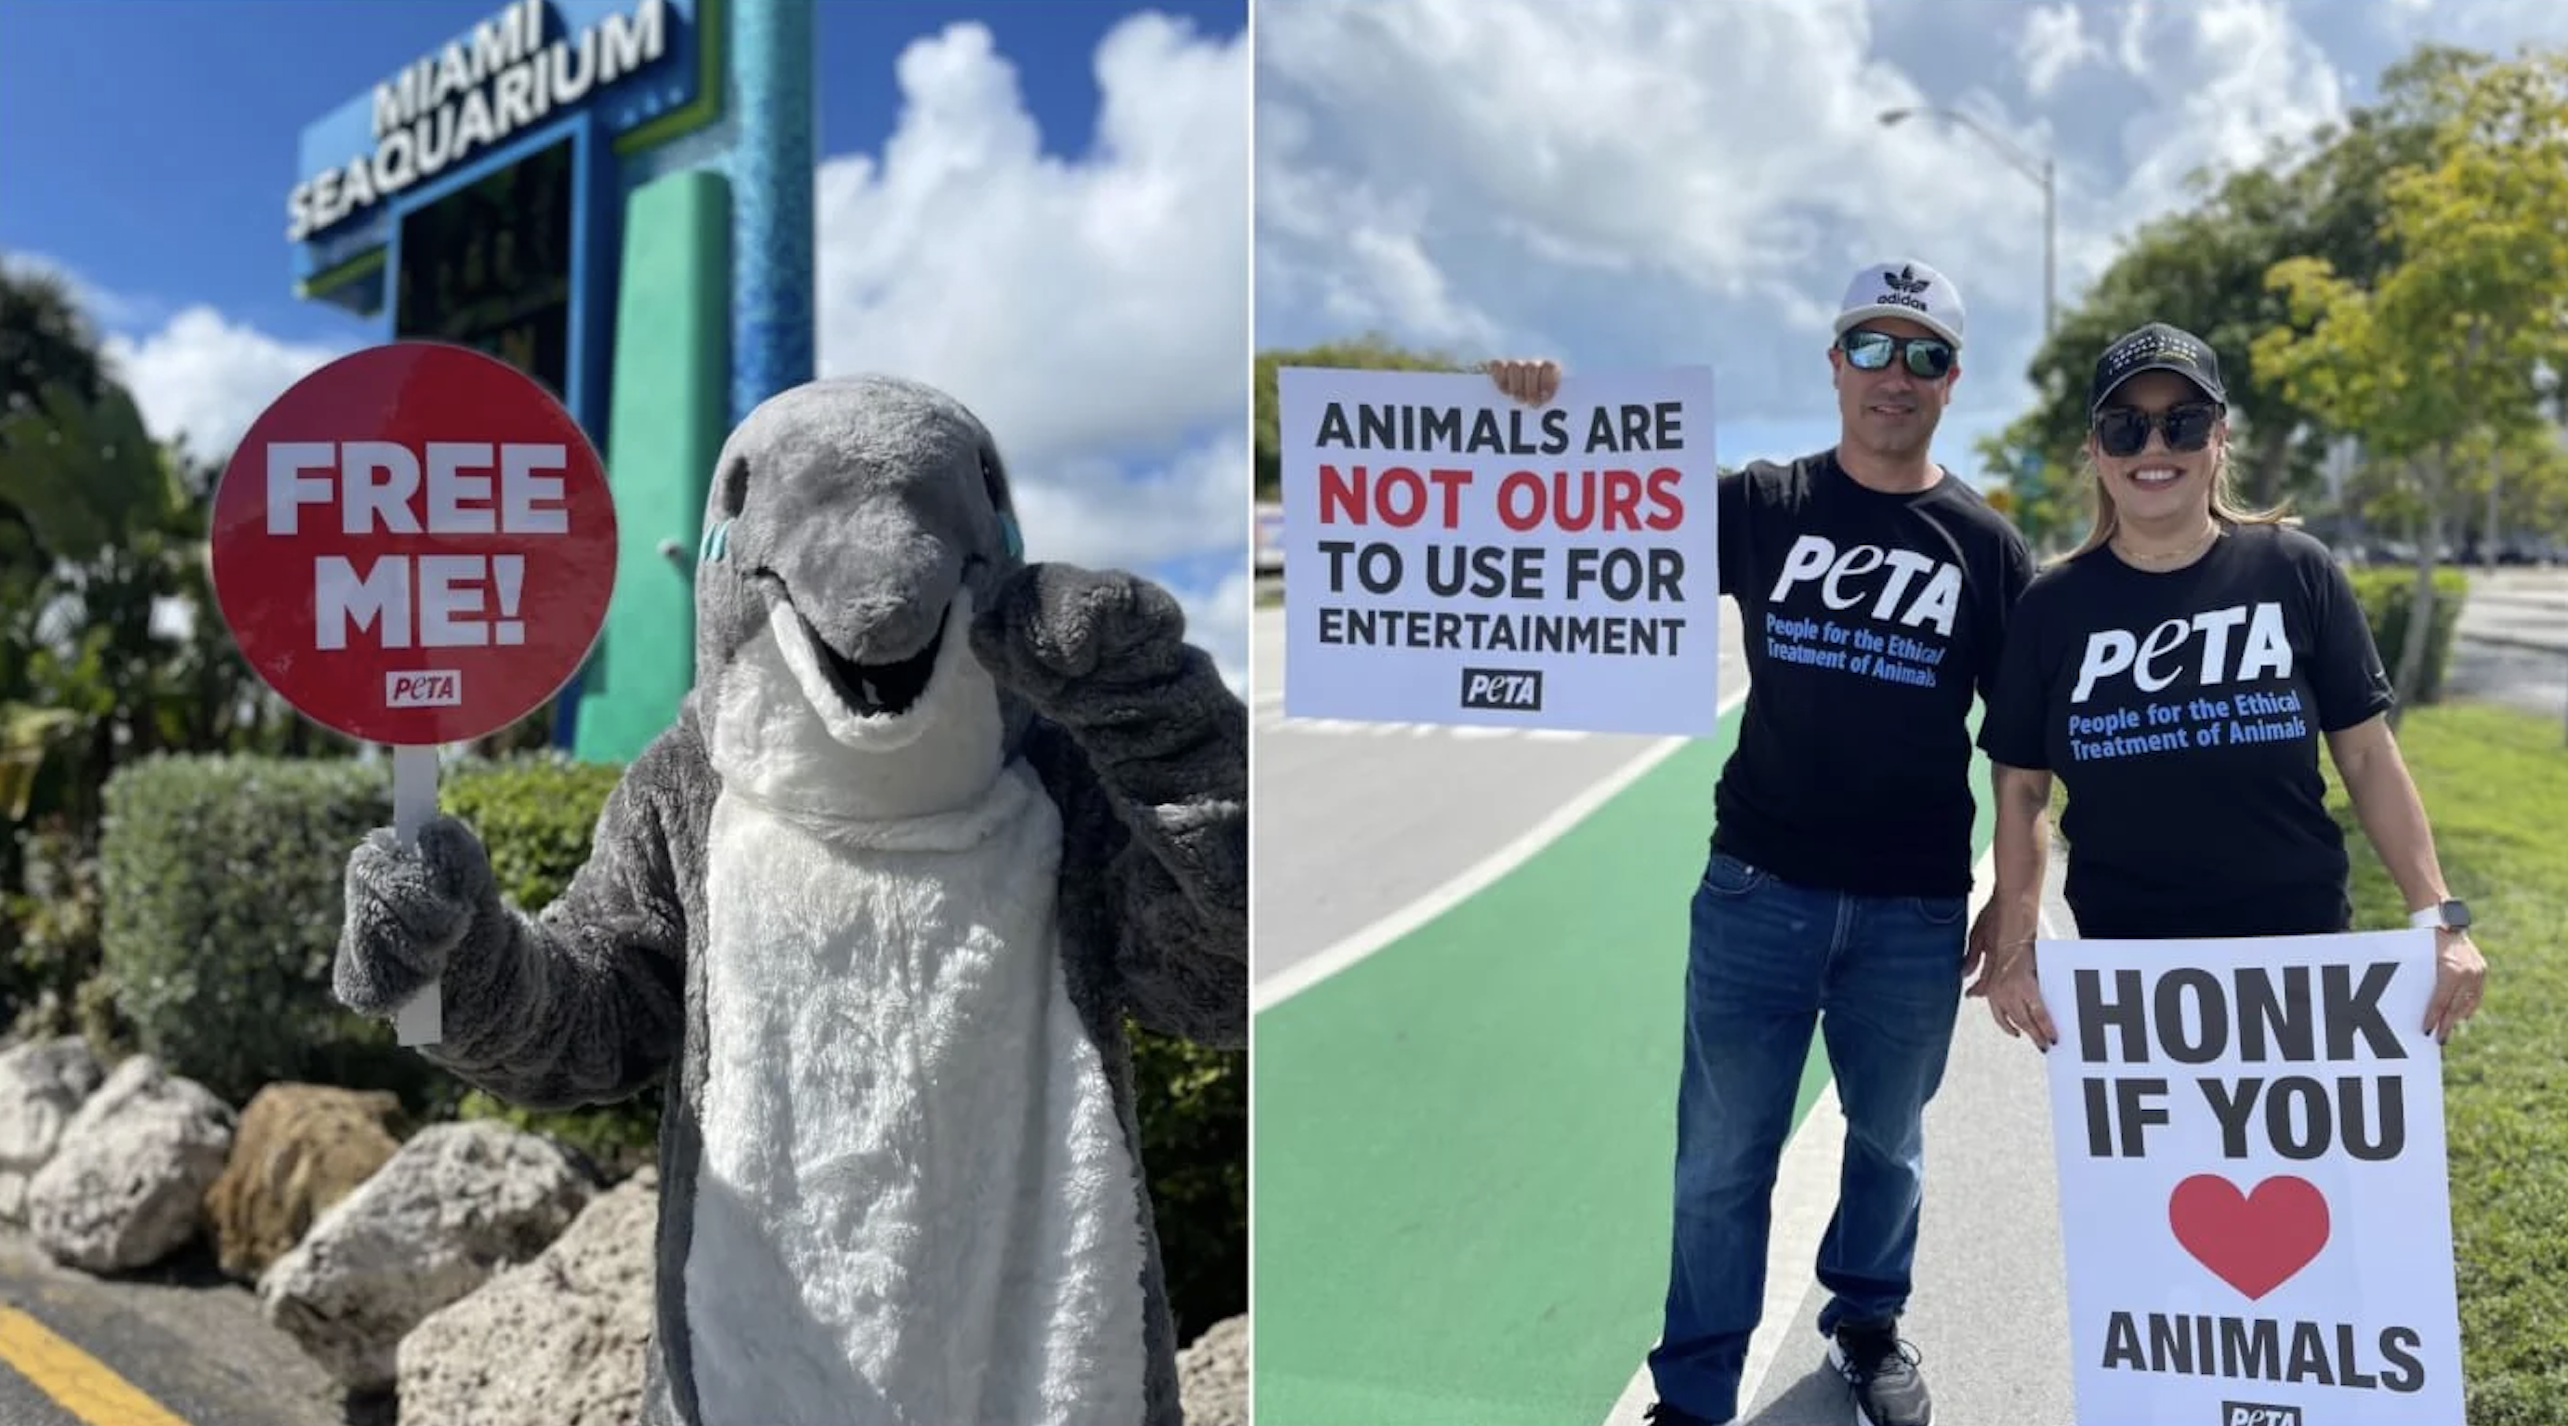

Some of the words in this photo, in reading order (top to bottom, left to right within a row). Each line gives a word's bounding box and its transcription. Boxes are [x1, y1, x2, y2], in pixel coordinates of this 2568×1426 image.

[372, 0, 544, 137] MIAMI
[285, 0, 667, 243] SEAQUARIUM
[1877, 293, 1927, 312] adidas
[1316, 401, 1570, 455] ANIMALS
[1585, 402, 1684, 454] ARE
[266, 440, 568, 535] FREE
[1319, 464, 1473, 529] NOT
[1496, 467, 1685, 532] OURS
[314, 554, 526, 651] ME!
[1318, 541, 1403, 594] TO
[1426, 545, 1545, 600] USE
[1566, 548, 1685, 602] FOR
[1319, 607, 1686, 657] ENTERTAINMENT
[1766, 612, 1819, 643] People
[1823, 621, 1850, 645] for
[1854, 628, 1884, 653] the
[1888, 634, 1946, 665] Ethical
[1767, 636, 1847, 670] Treatment
[1850, 655, 1872, 675] of
[1872, 657, 1937, 688] Animals
[2069, 708, 2140, 736] People
[2147, 703, 2182, 726] for
[2189, 697, 2230, 721] the
[2234, 689, 2301, 717] Ethical
[2070, 728, 2189, 761] Treatment
[2196, 723, 2221, 747] of
[2229, 716, 2306, 744] Animals
[2074, 962, 2408, 1064] HONK
[2082, 1077, 2170, 1158] IF
[2196, 1075, 2406, 1161] YOU
[2102, 1310, 2425, 1393] ANIMALS
